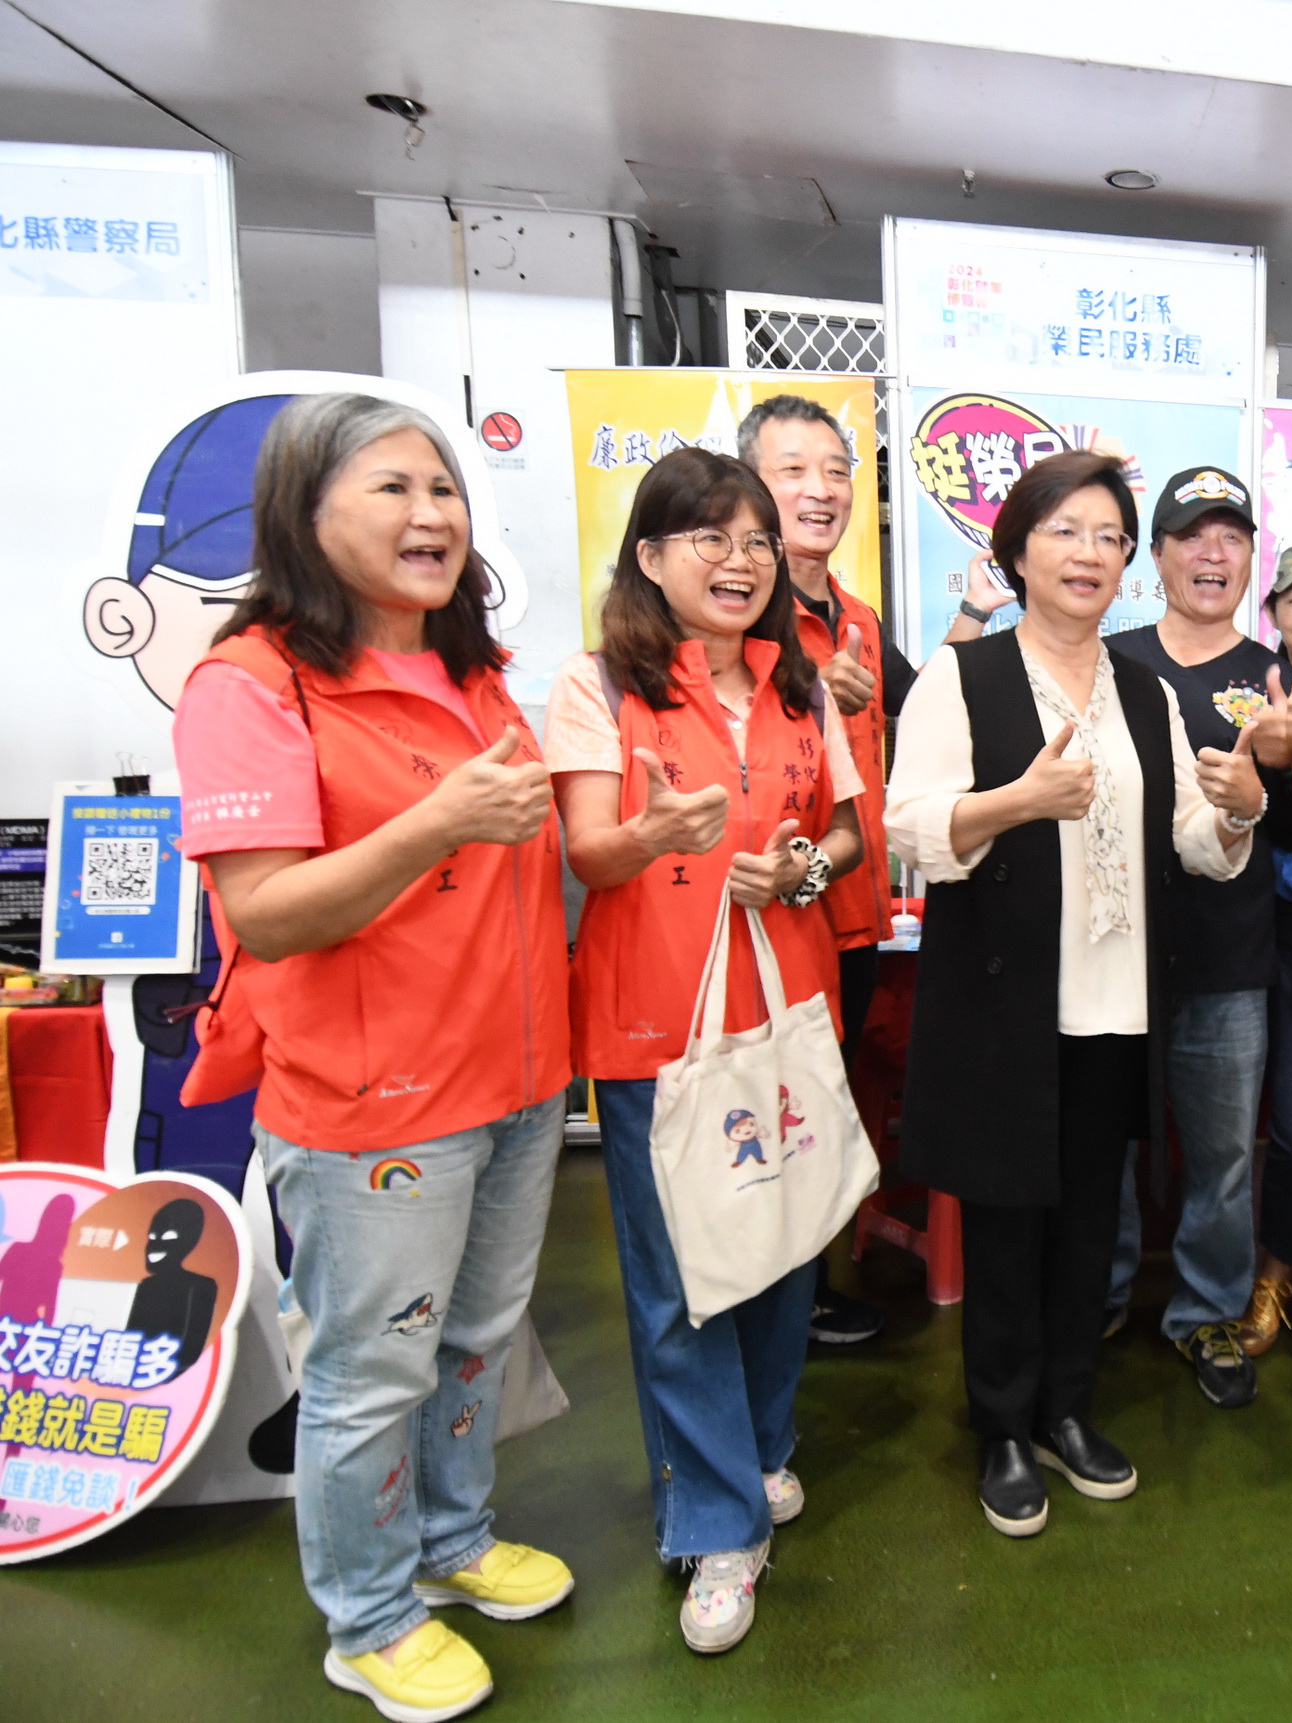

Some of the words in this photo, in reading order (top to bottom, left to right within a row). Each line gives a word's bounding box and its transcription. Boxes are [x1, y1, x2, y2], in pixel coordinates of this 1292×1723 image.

[1076, 288, 1171, 324] 彰化縣
[1043, 324, 1202, 366] 榮民服務處
[0, 1385, 171, 1464] 錢就是騙
